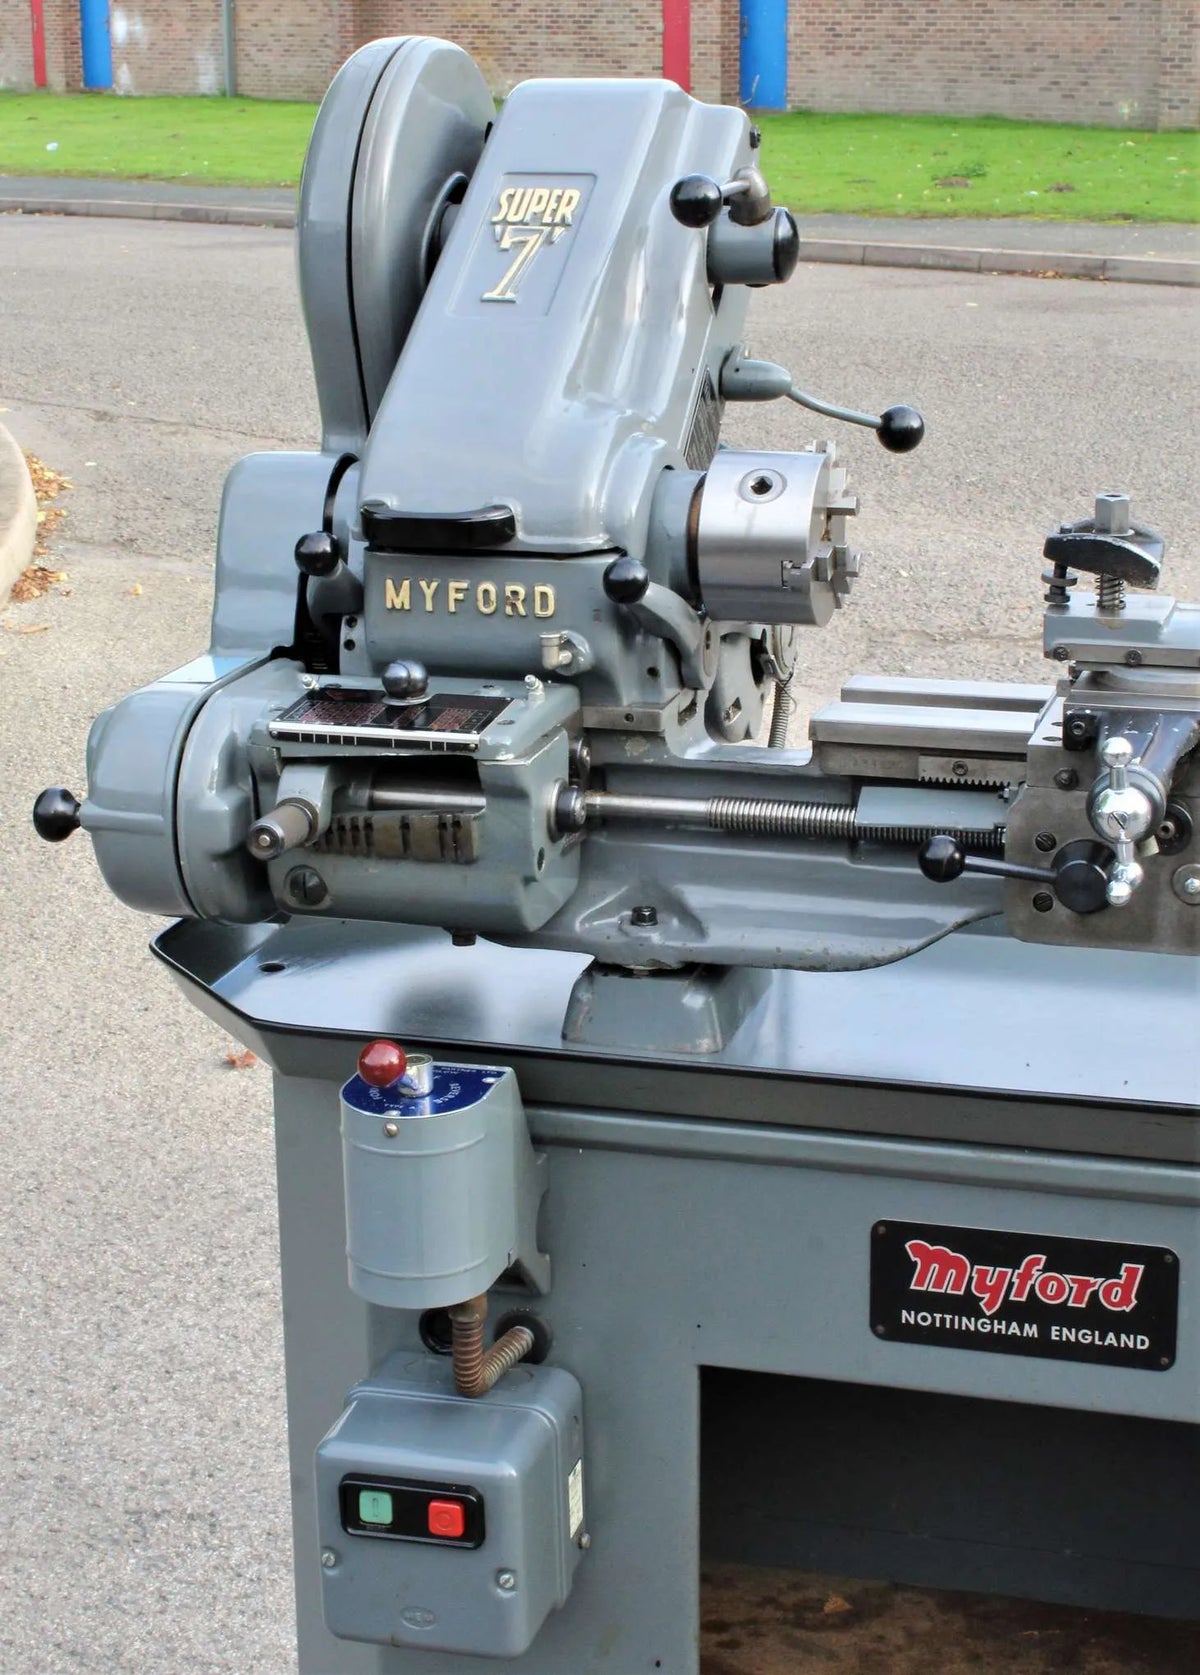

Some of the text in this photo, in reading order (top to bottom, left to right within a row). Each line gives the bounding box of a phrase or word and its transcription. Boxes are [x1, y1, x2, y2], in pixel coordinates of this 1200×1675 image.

[491, 187, 581, 226] SUPER
[385, 577, 556, 618] MYFORD
[904, 1239, 1145, 1316] Myford
[901, 1309, 1150, 1350] NOTTINGHAM ENGLAND
